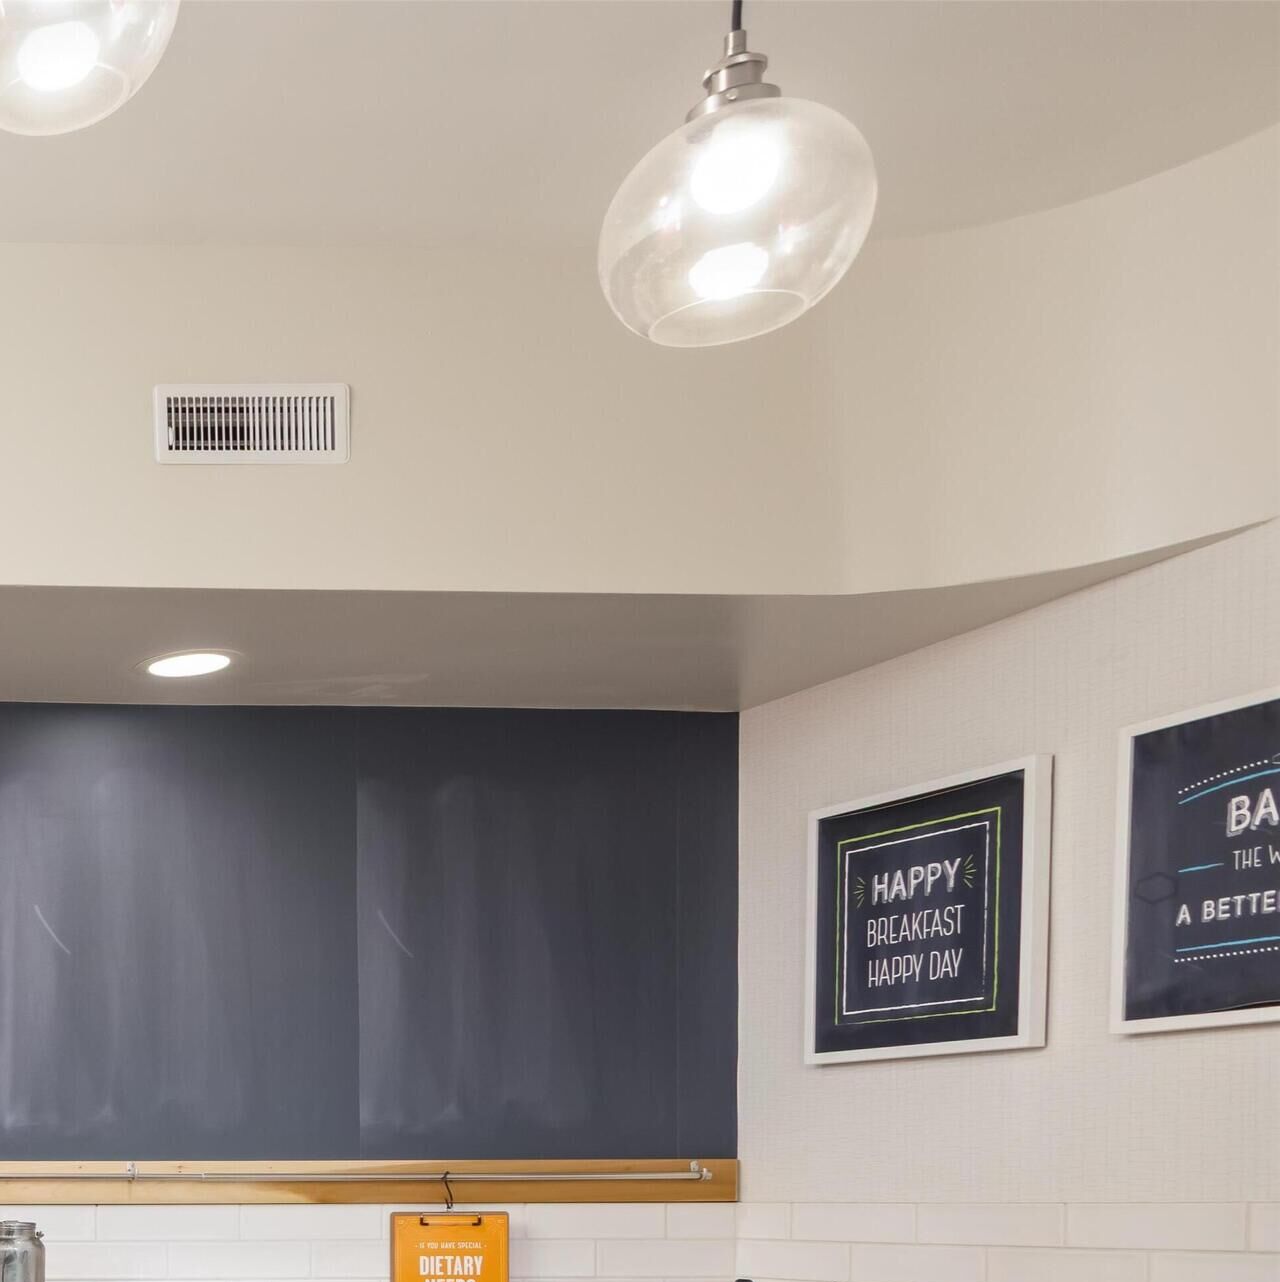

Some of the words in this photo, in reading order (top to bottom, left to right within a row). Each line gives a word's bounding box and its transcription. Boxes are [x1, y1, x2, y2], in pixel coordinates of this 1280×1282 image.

[1233, 846, 1263, 870] THE
[872, 858, 961, 906] HAPPY
[867, 904, 966, 948] BREAKFAST
[1175, 903, 1192, 926] A
[868, 953, 924, 988] HAPPY
[929, 948, 963, 980] DAY
[419, 1255, 483, 1276] DIETARY
